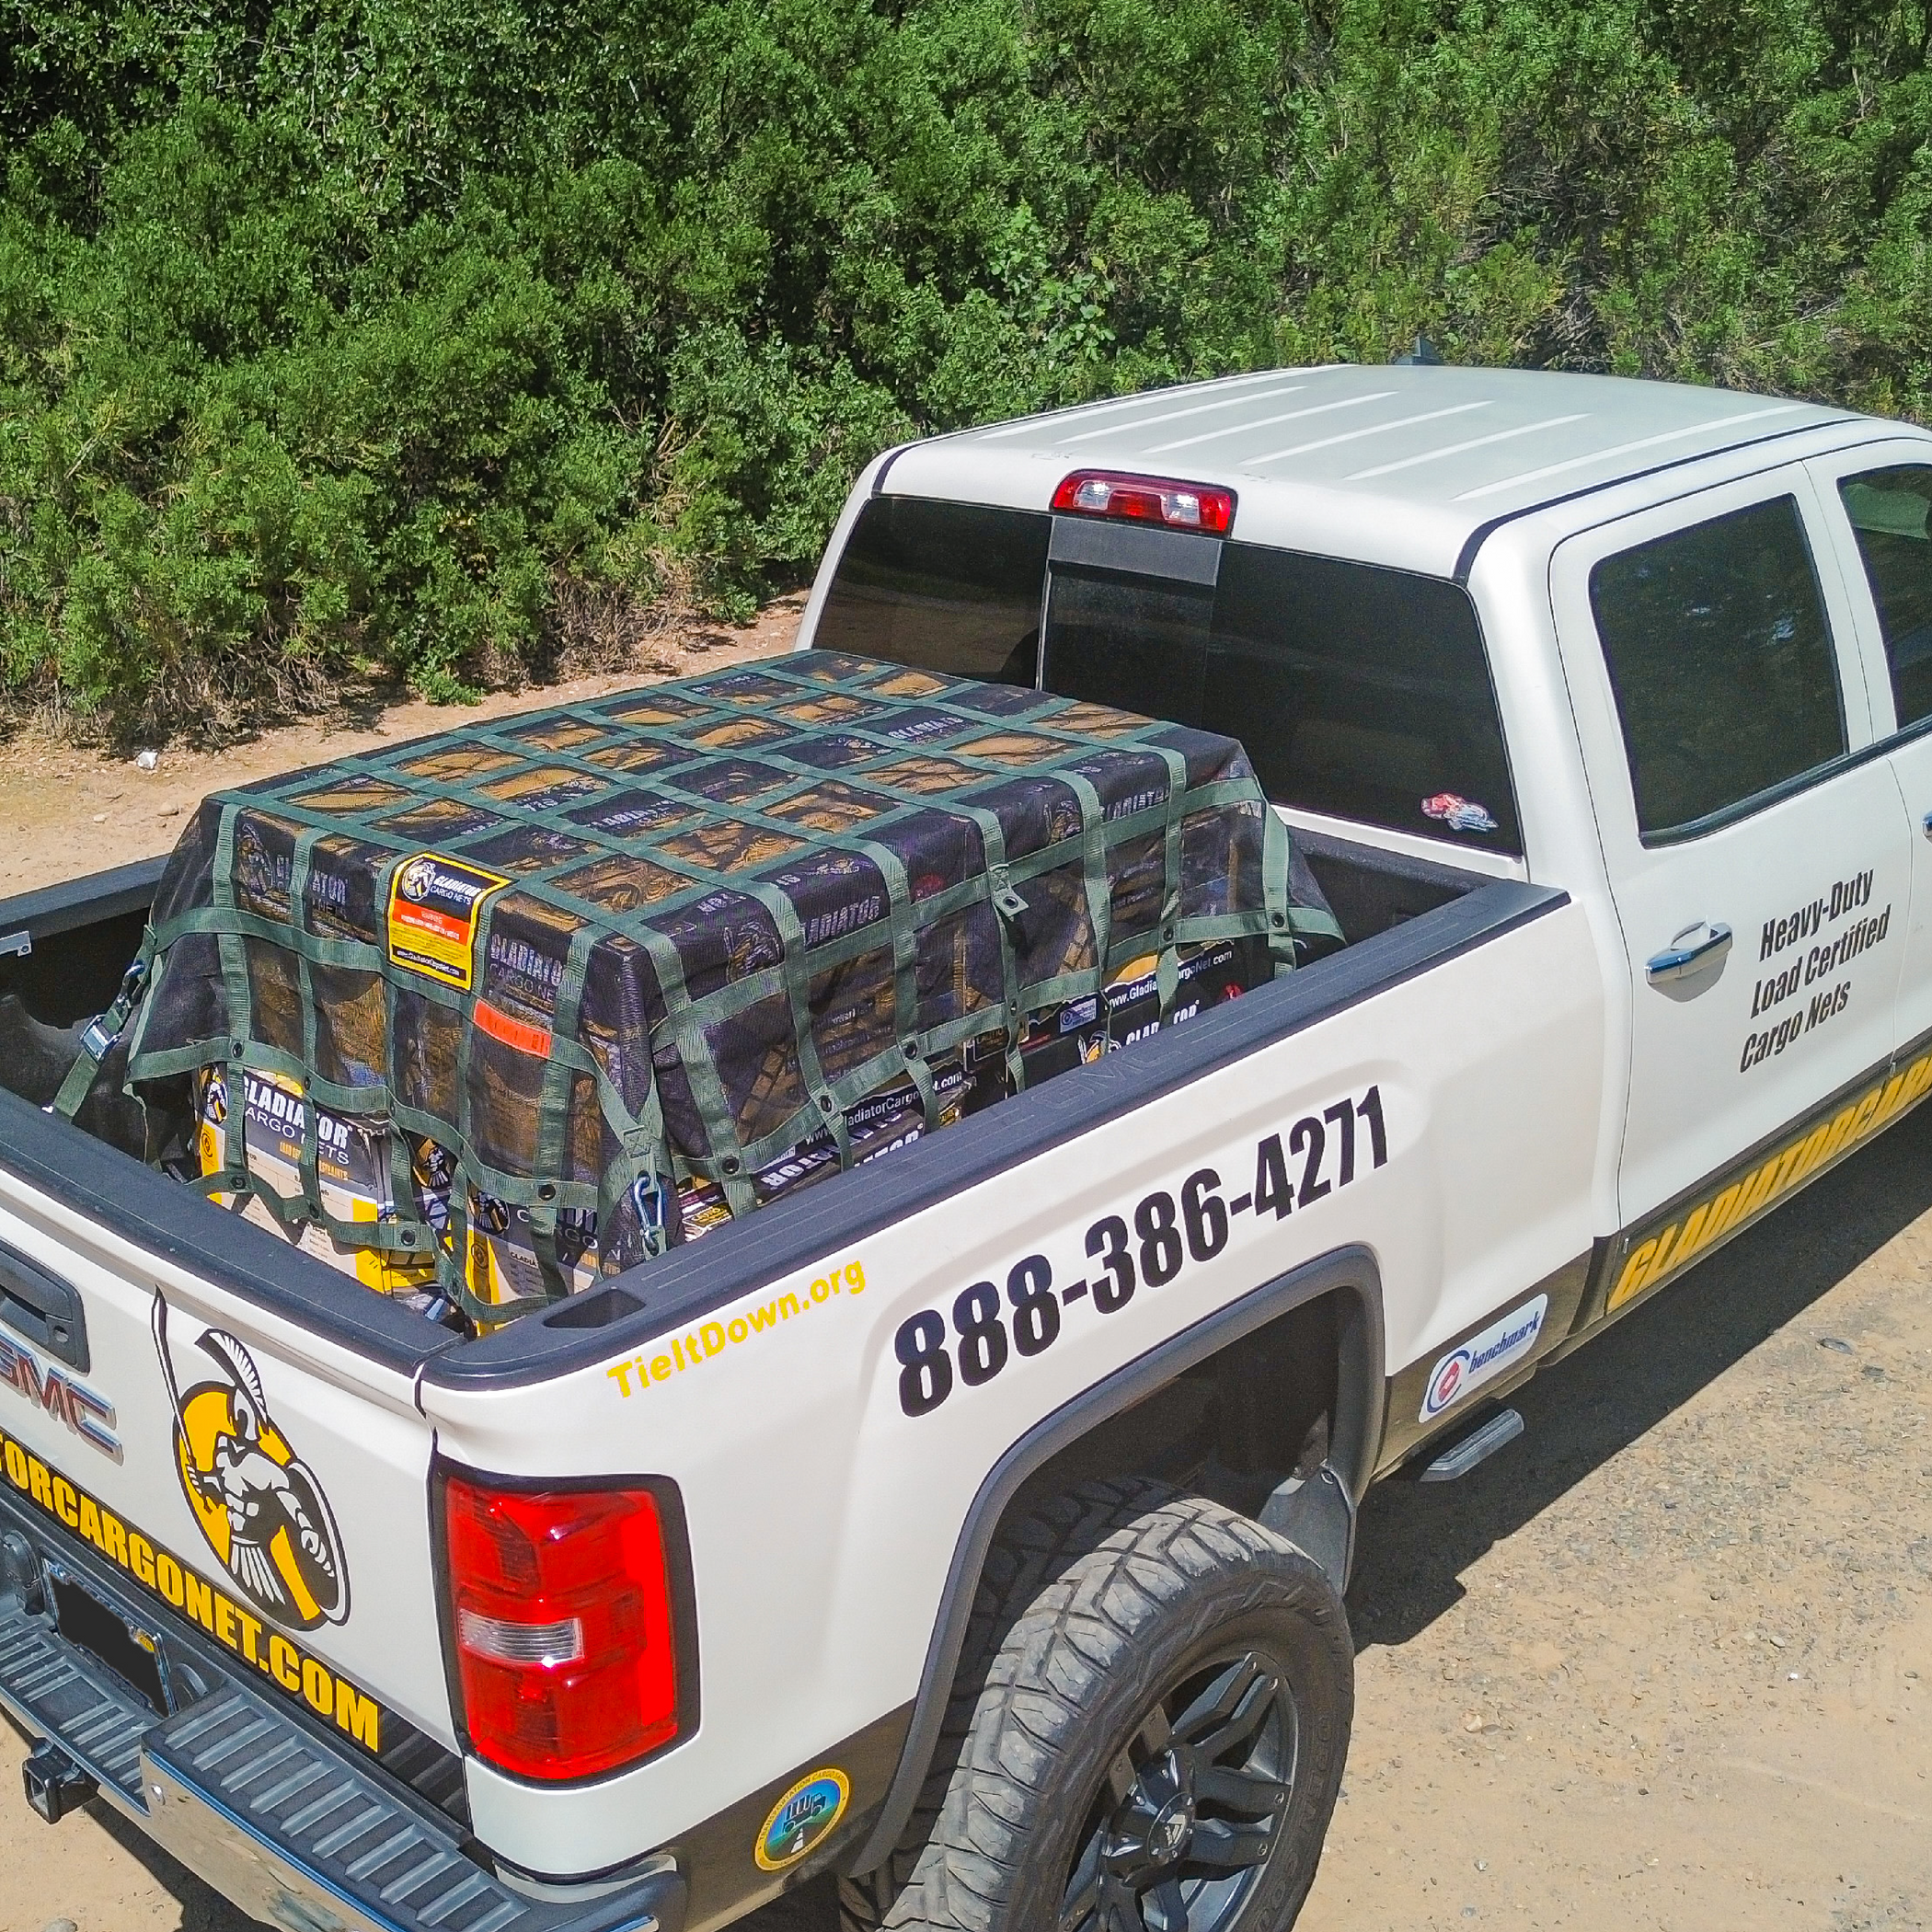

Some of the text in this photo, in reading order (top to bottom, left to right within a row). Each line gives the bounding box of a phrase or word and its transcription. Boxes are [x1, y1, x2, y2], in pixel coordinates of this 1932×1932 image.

[491, 933, 563, 986] GLADIATO
[1759, 868, 1874, 961] Heavy-Duty
[1750, 903, 1892, 1019] Load Certified
[1740, 981, 1851, 1073] Cargo Nets
[244, 1076, 348, 1149] LADIAOR
[245, 1107, 295, 1139] ARGO
[301, 1133, 350, 1165] ETS
[892, 1086, 1390, 1419] 888-386-4271
[607, 1259, 867, 1397] TieItDown.org
[1468, 1311, 1540, 1374] benchmark
